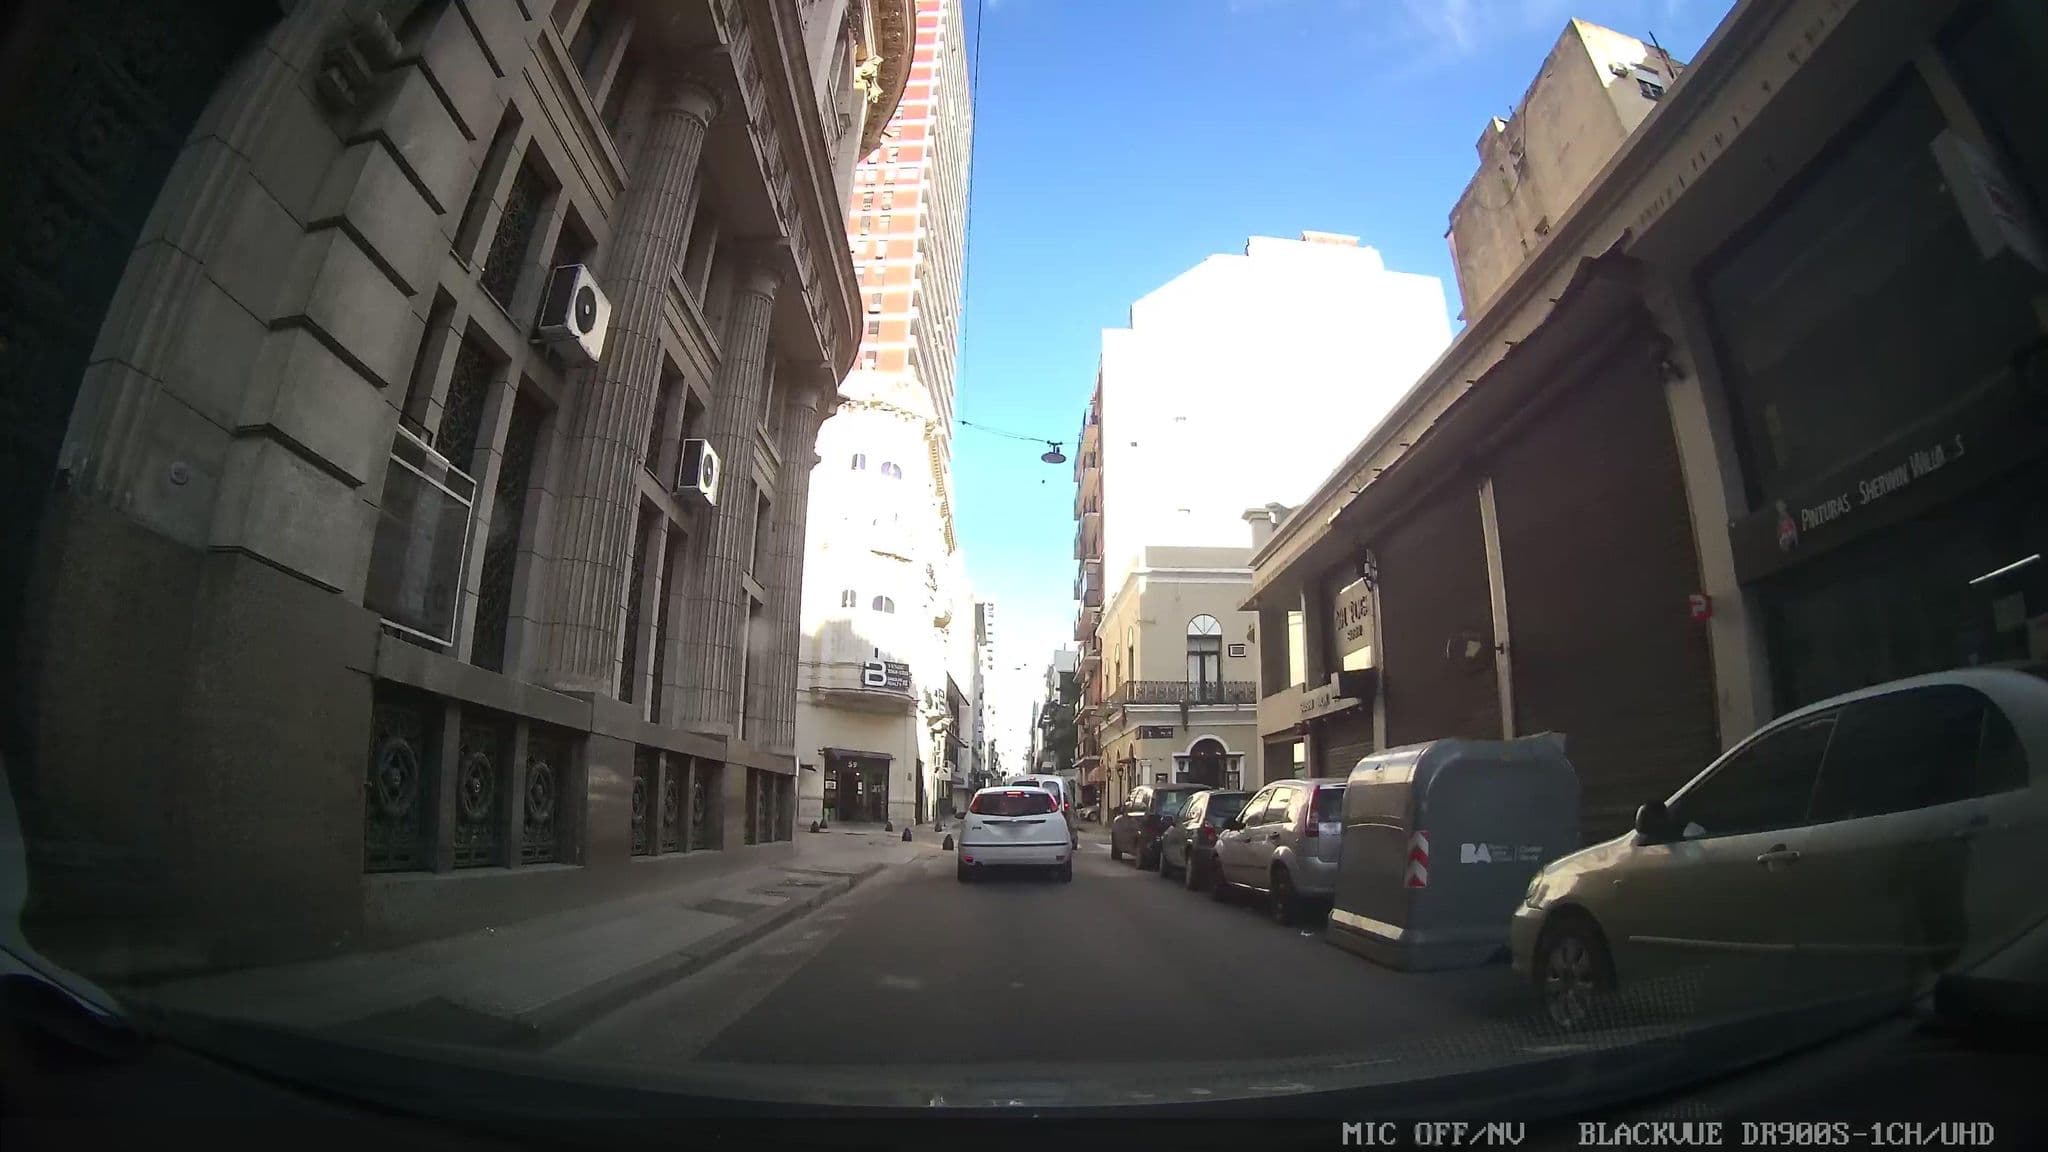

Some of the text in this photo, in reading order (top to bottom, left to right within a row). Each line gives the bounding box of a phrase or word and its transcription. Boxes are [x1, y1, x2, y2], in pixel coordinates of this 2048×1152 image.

[1800, 493, 1851, 532] PINTURAS
[1858, 462, 1911, 505] SHERWIN
[1460, 842, 1493, 864] BA
